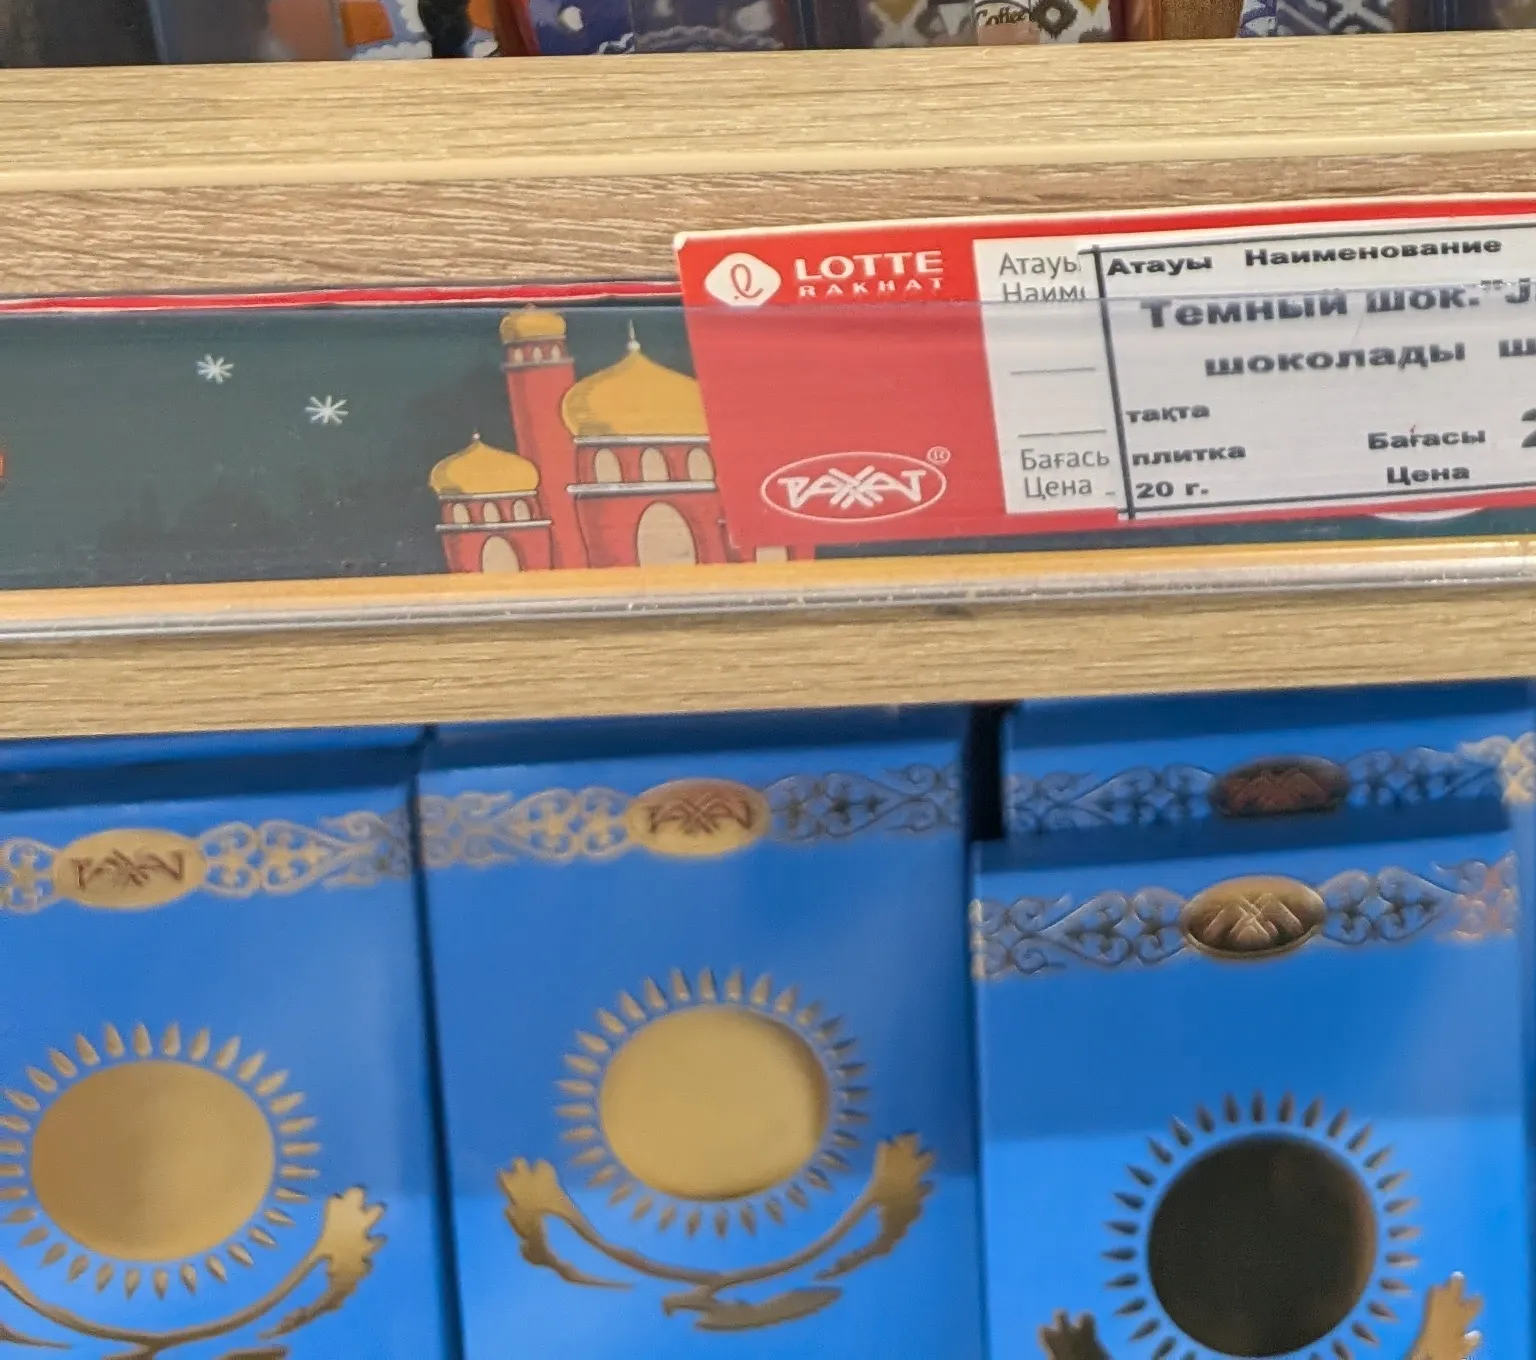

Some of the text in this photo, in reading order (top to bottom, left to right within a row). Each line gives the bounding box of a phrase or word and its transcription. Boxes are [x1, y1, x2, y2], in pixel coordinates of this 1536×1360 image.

[793, 249, 944, 281] LOTTE
[1106, 238, 1502, 277] Атауы Наименование
[798, 276, 945, 299] RAKHAT
[1140, 292, 1349, 329] Темный
[1204, 342, 1465, 377] шоколады
[1125, 404, 1211, 425] тақта
[1366, 429, 1486, 451] Бағасы
[1131, 445, 1247, 467] плитка
[1386, 465, 1471, 486] Цена
[1022, 476, 1093, 501] Цена
[1135, 480, 1209, 499] 20 г.
